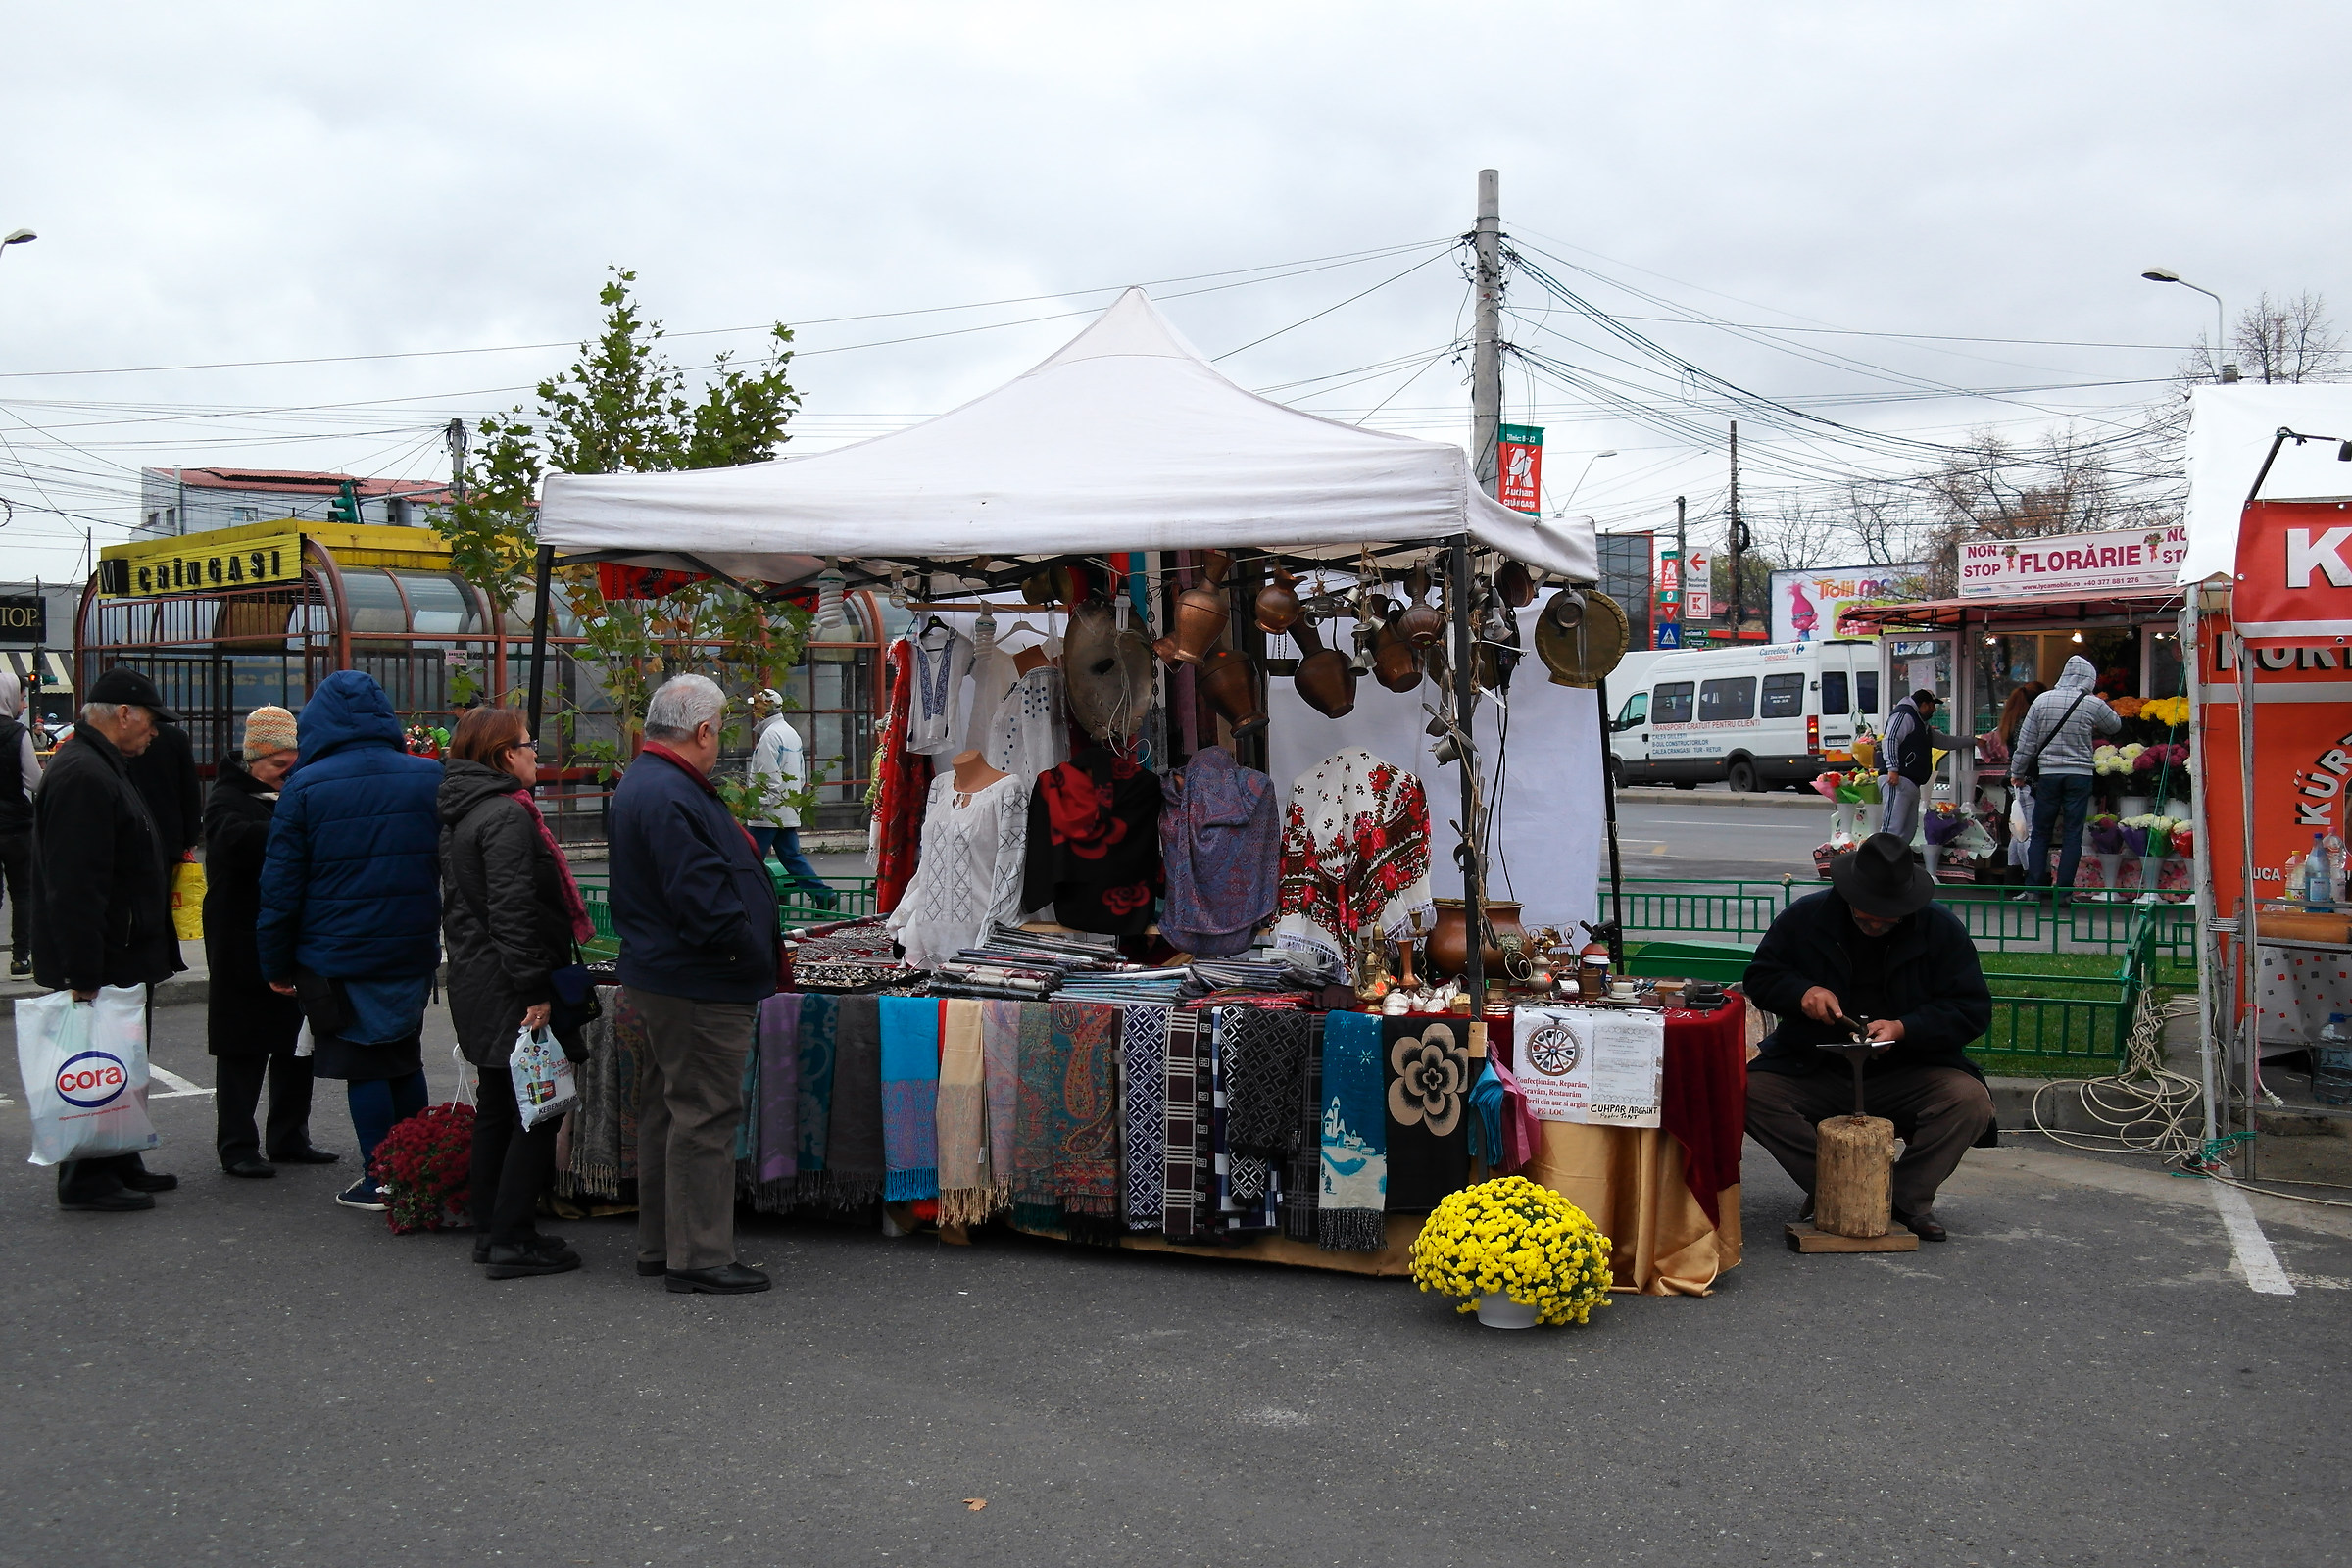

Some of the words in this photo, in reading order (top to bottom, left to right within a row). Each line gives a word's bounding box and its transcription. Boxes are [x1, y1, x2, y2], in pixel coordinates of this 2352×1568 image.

[1967, 545, 1997, 558] NON
[2019, 543, 2142, 574] FLORĂRIE
[1964, 564, 2001, 577] STOP
[1812, 578, 1855, 600] Trolii
[2022, 581, 2080, 590] www.lycamobile.ro
[1759, 647, 1789, 656] Carrefour
[2242, 866, 2280, 881] UCA
[59, 1066, 123, 1092] cora
